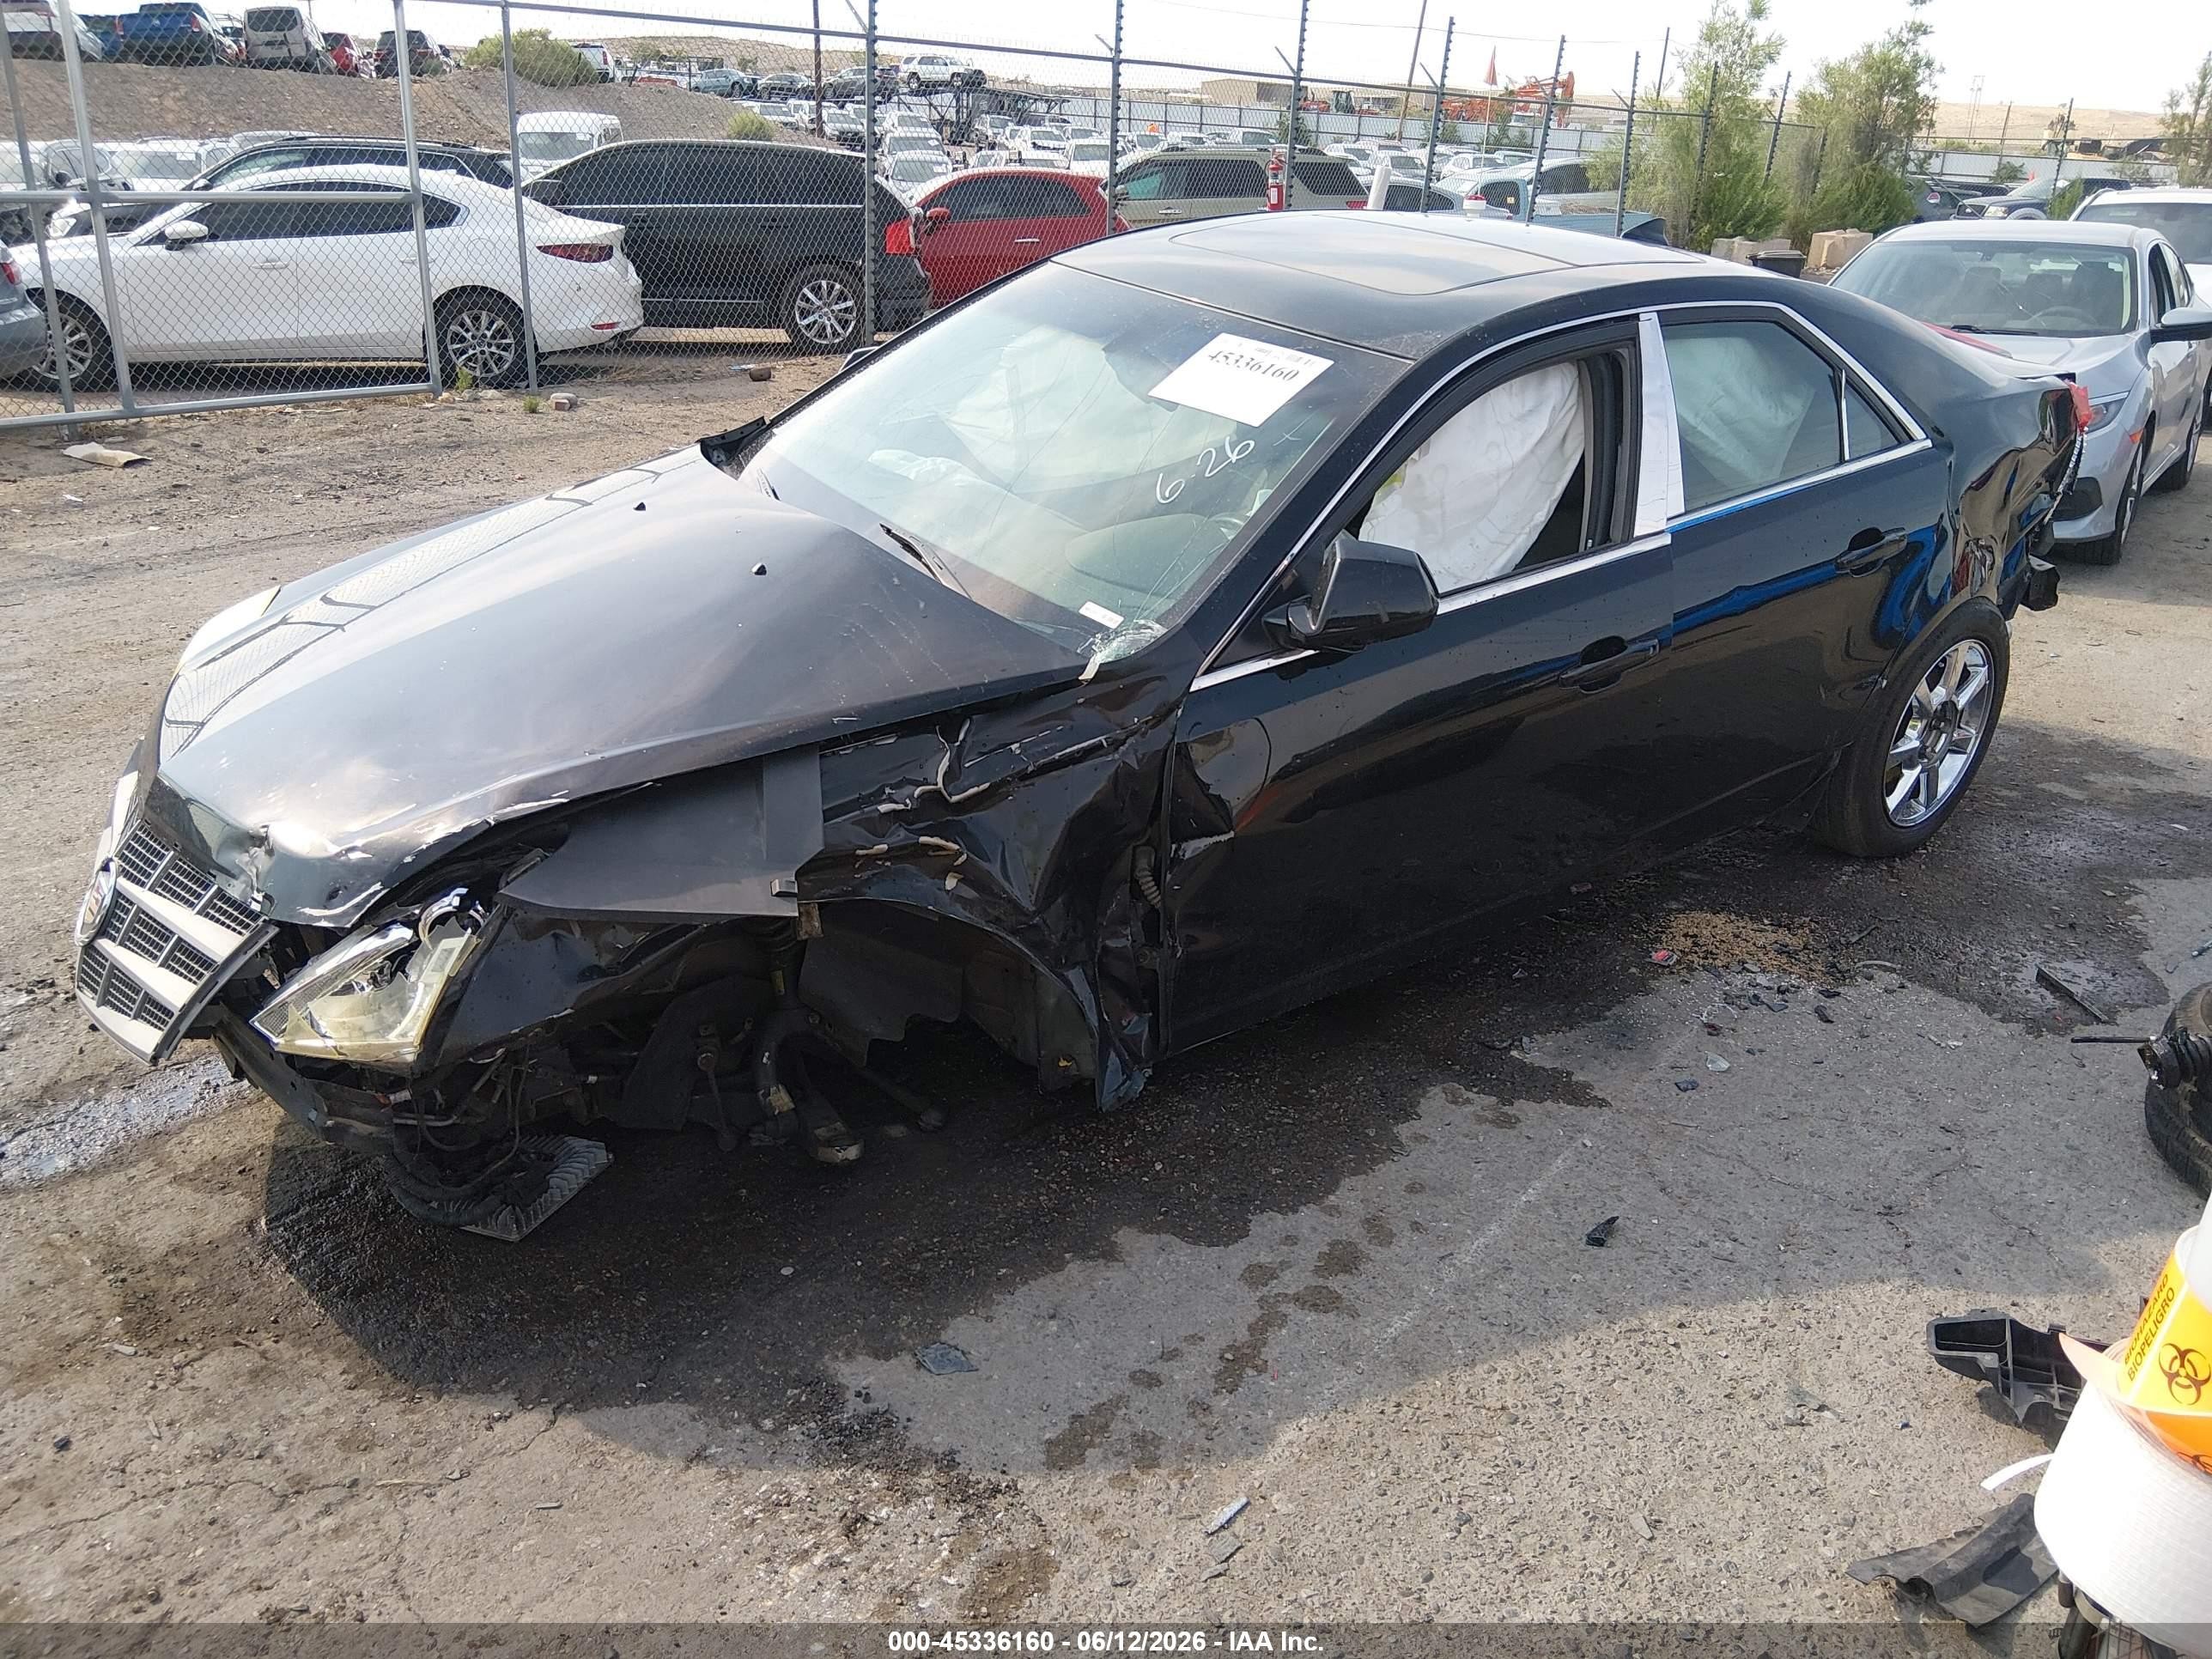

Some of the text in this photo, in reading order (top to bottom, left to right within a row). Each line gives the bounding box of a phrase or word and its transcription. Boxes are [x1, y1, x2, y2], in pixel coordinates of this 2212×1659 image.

[1208, 349, 1300, 381] 45336160
[2124, 1273, 2168, 1365] BIOHAZARD
[2127, 1286, 2175, 1382] BIOPELIGRO
